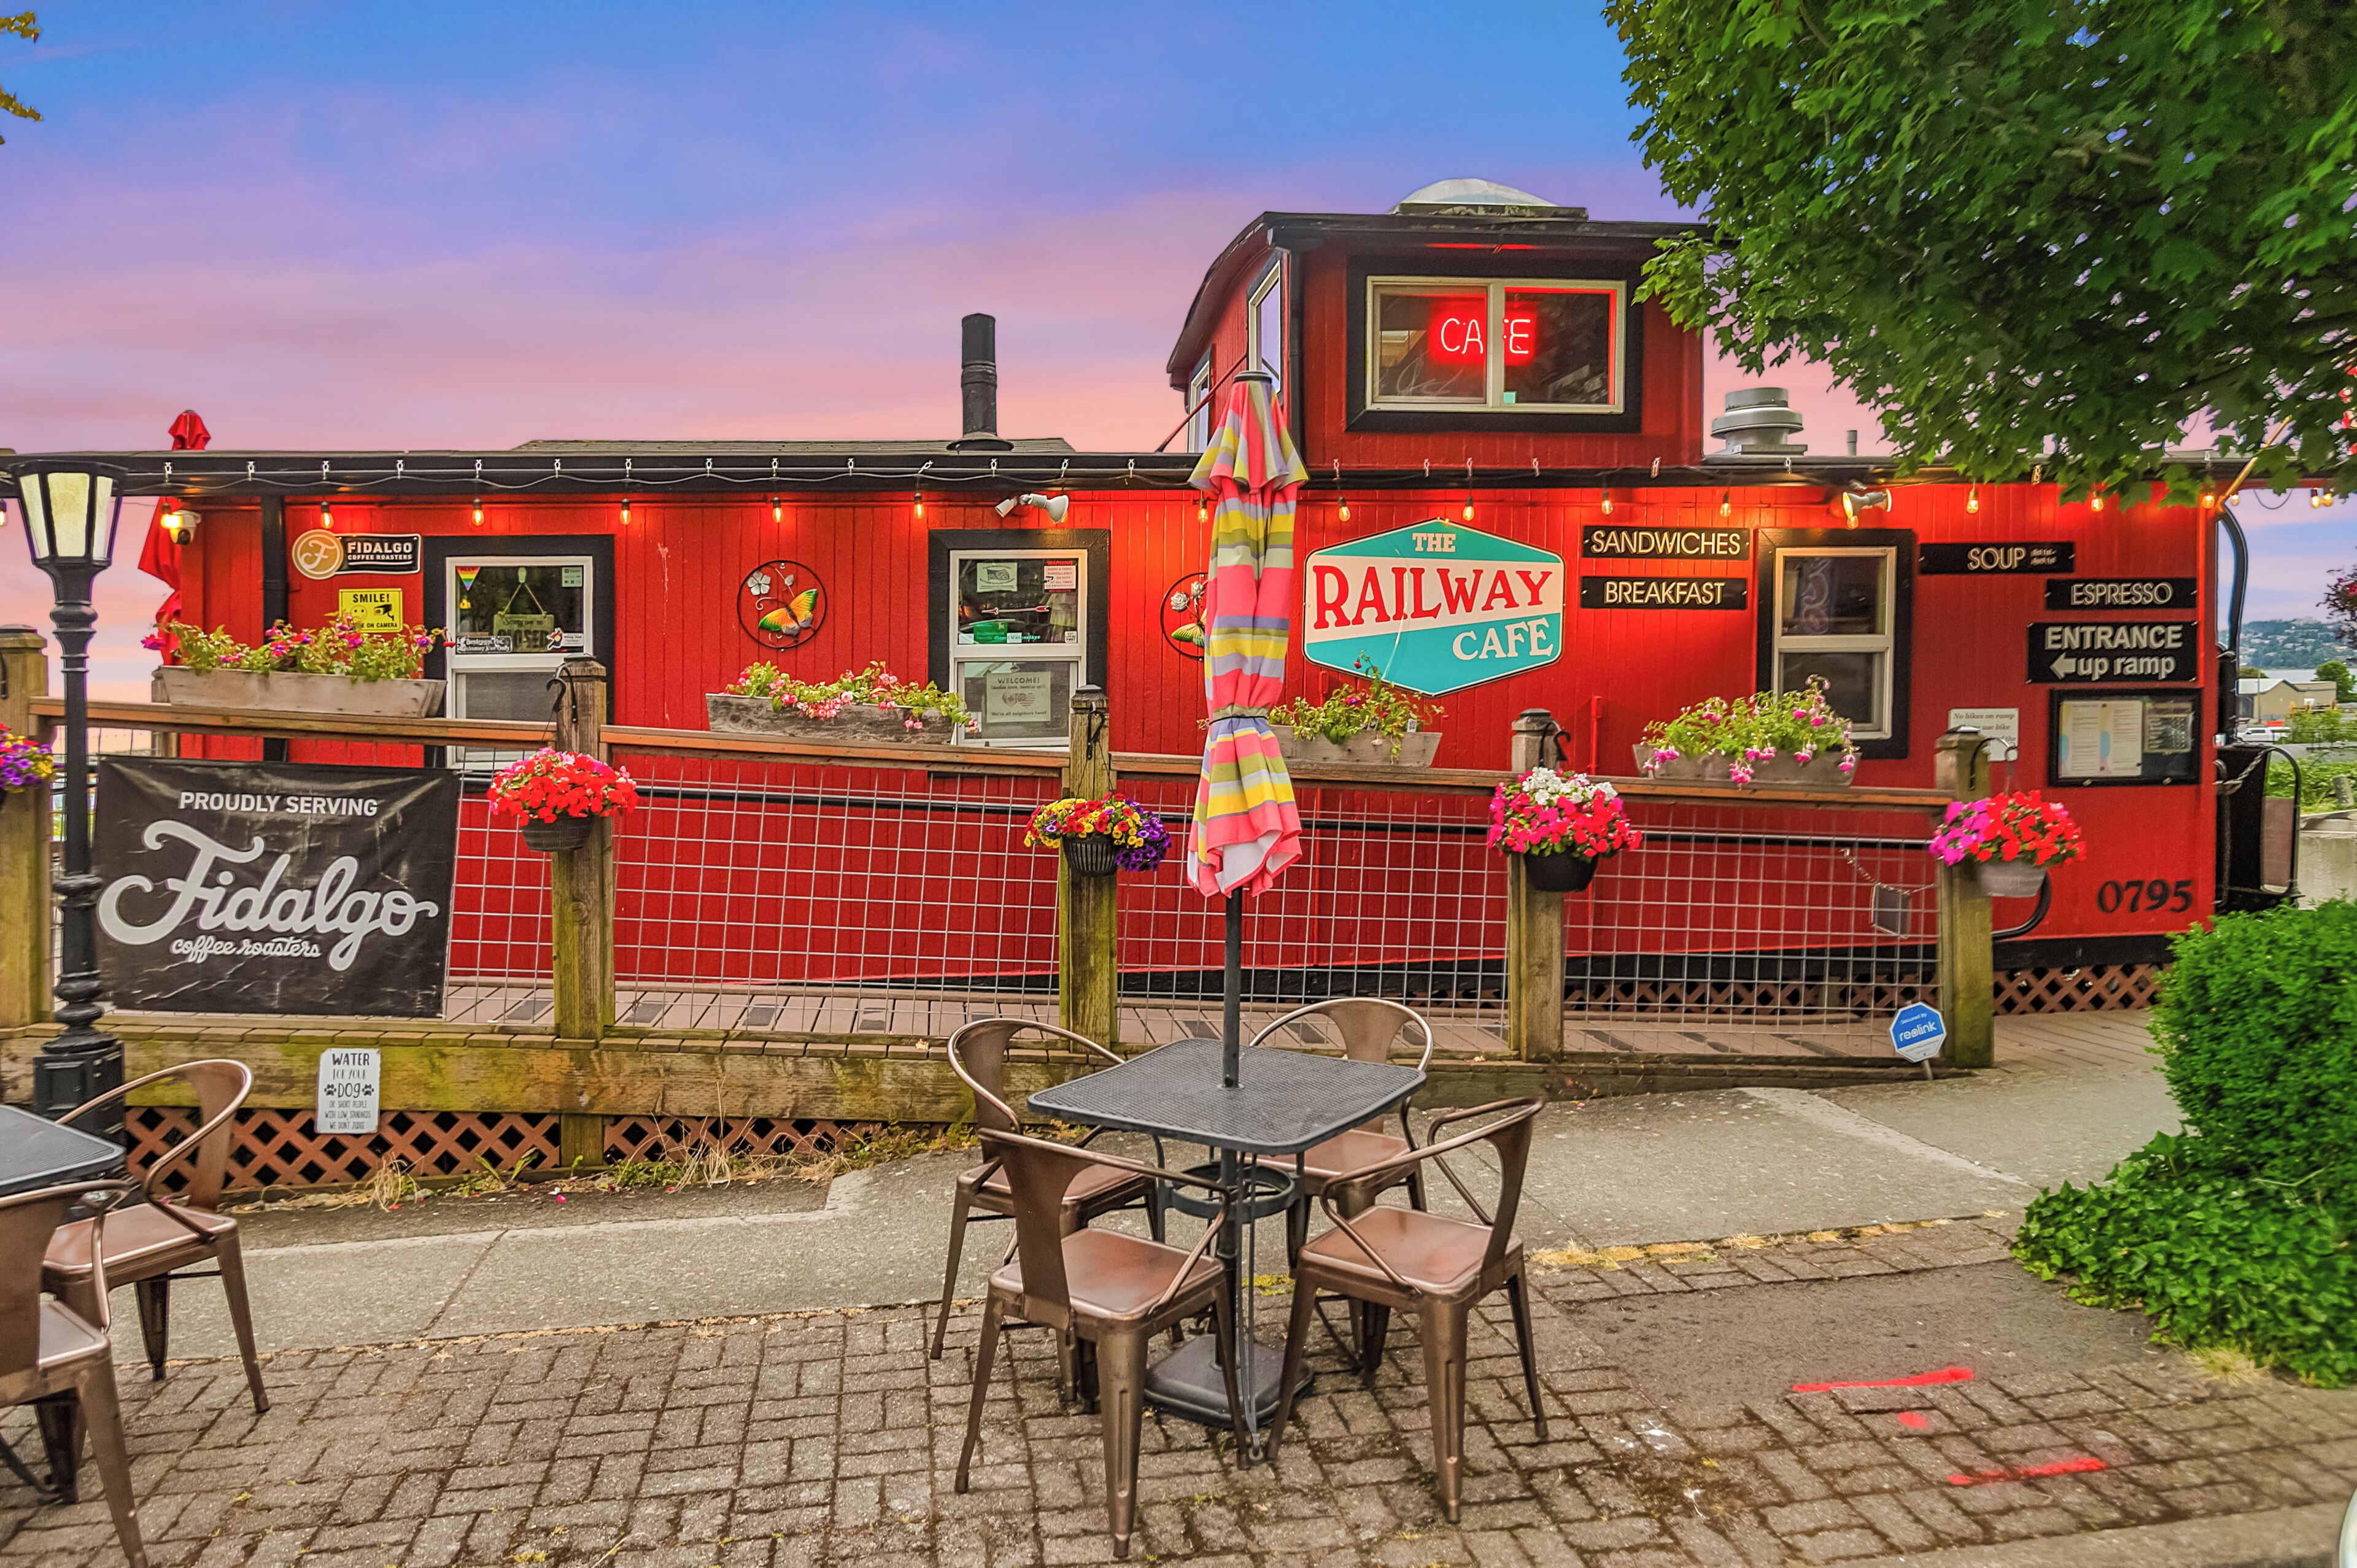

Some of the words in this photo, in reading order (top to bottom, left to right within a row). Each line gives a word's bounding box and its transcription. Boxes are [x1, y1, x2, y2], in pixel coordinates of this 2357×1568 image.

[1441, 318, 1530, 354] CAE
[347, 542, 412, 554] FIDALGO
[1412, 533, 1456, 552] THE
[1590, 529, 1741, 555] SANDWICHES
[1967, 547, 2027, 571] SOUP
[353, 593, 390, 603] SMILE!
[1313, 565, 1553, 630] RAILWAY
[1604, 581, 1726, 604] BREAKFAST
[2071, 582, 2173, 605] ESPRESSO
[1452, 617, 1554, 661] CAFE
[2045, 625, 2183, 650] ENTRANCE
[2077, 656, 2110, 681] up
[2113, 656, 2177, 681] ramp
[179, 792, 280, 813] PROUDLY
[286, 795, 378, 816] SERVING
[96, 819, 438, 971] Fidalgo
[2097, 879, 2194, 914] 0795
[170, 935, 237, 964] coffee
[237, 937, 322, 959] roasters
[1899, 1021, 1937, 1041] reolink
[332, 1053, 370, 1065] WATER
[333, 1069, 345, 1079] FOR
[348, 1069, 367, 1079] YOUR
